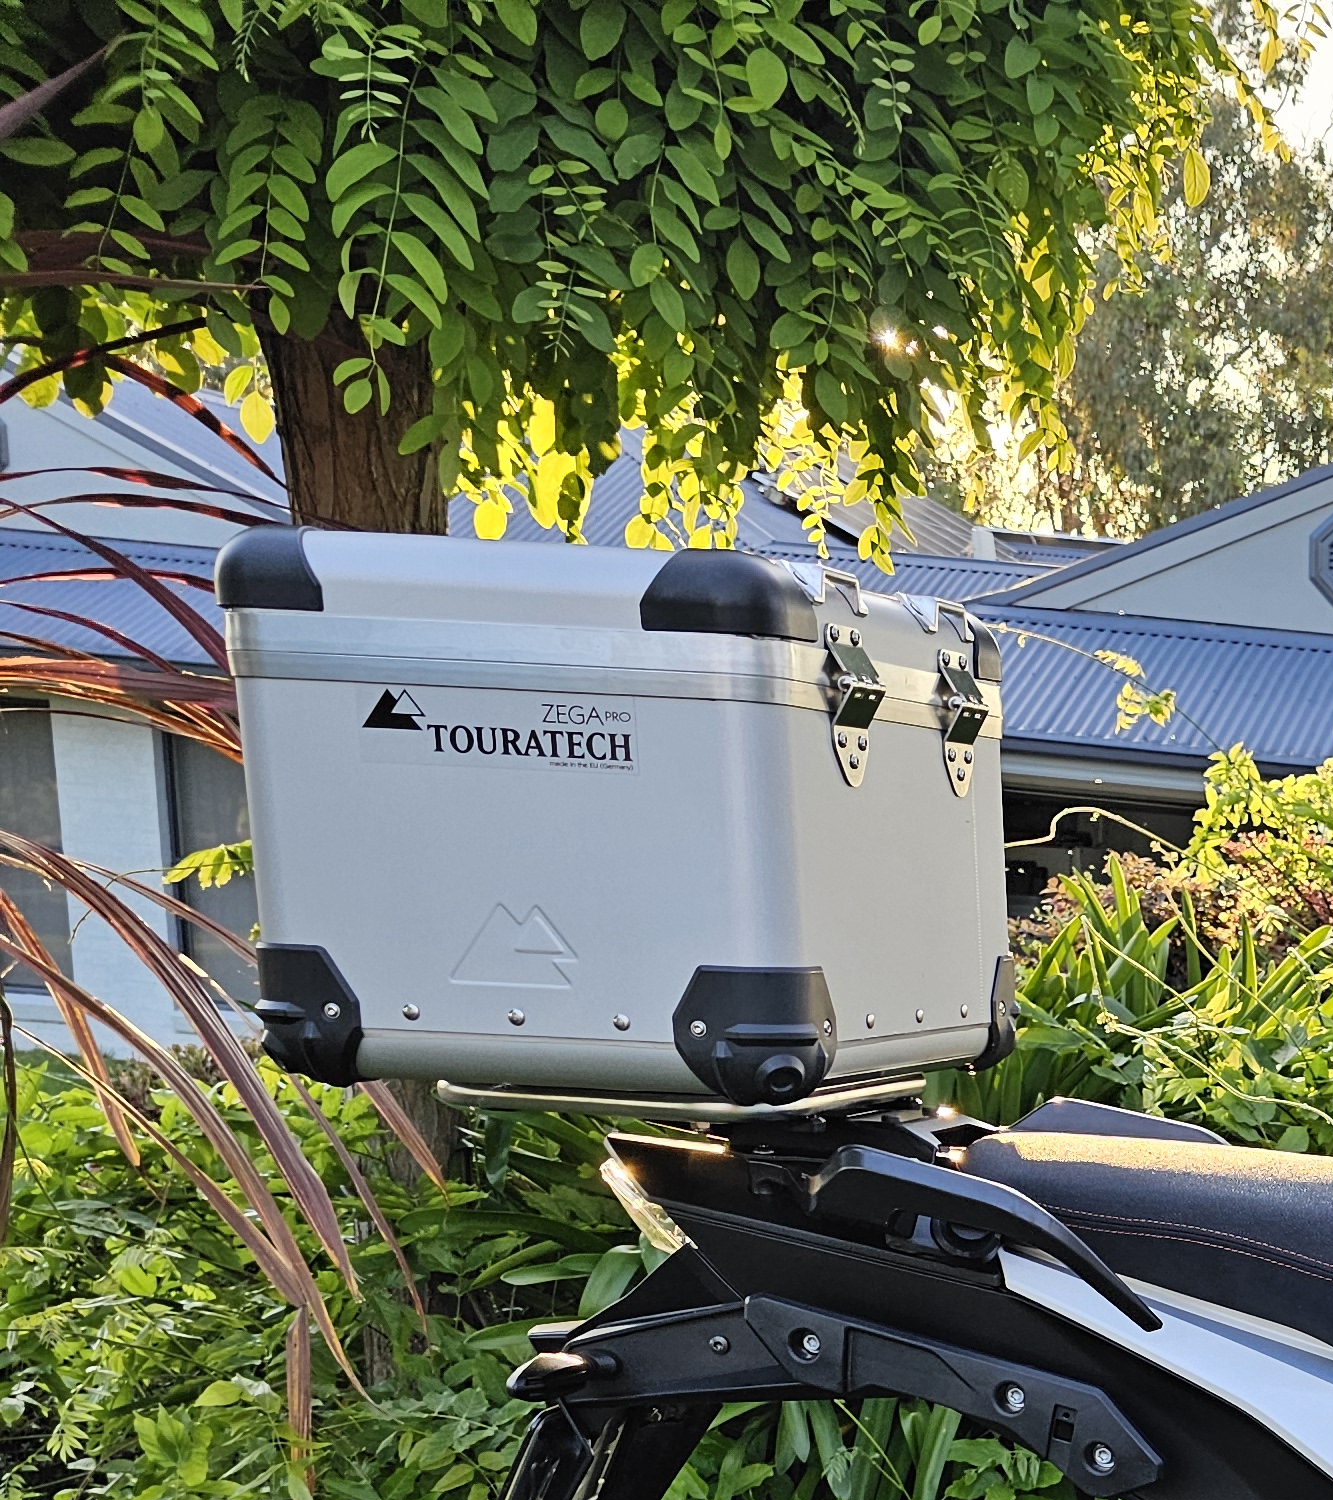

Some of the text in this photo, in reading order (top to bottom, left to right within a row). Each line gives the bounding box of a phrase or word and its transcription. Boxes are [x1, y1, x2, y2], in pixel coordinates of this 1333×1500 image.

[541, 703, 632, 726] ZEGA PRO
[427, 724, 634, 762] TOURATECH
[599, 763, 634, 772] (Germany)
